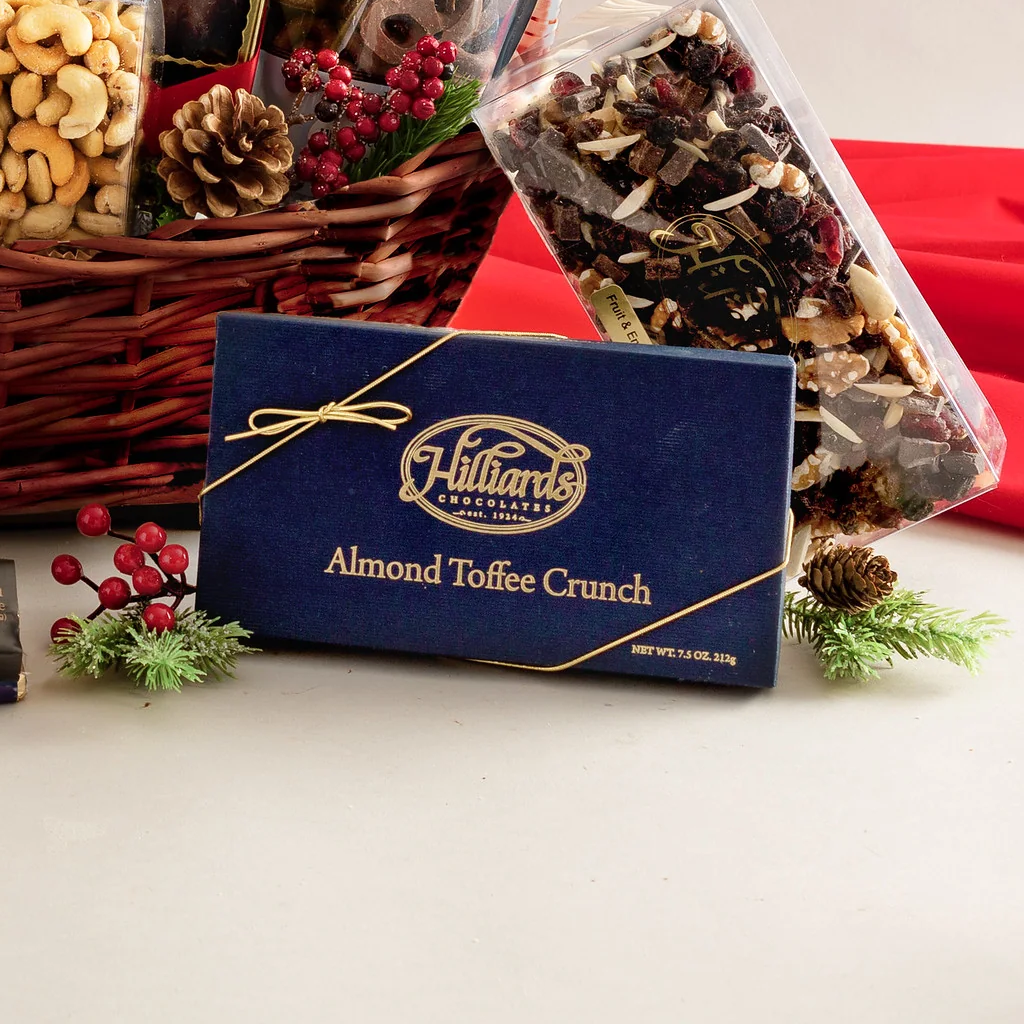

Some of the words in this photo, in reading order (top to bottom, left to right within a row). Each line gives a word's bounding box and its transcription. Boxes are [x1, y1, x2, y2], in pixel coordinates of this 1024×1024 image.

[606, 294, 626, 320] Fruit
[621, 321, 631, 330] &
[399, 424, 591, 502] Hilliards
[438, 494, 551, 513] CHOCOLATES
[467, 511, 487, 519] est.
[492, 512, 517, 521] 1924
[324, 546, 442, 585] Almond
[448, 557, 535, 593] Toffee
[543, 568, 652, 605] Crunch
[631, 644, 655, 656] NET
[656, 647, 676, 658] WT.
[678, 649, 692, 659] 7.5
[693, 650, 712, 661] OZ.
[714, 652, 737, 666] 212g
